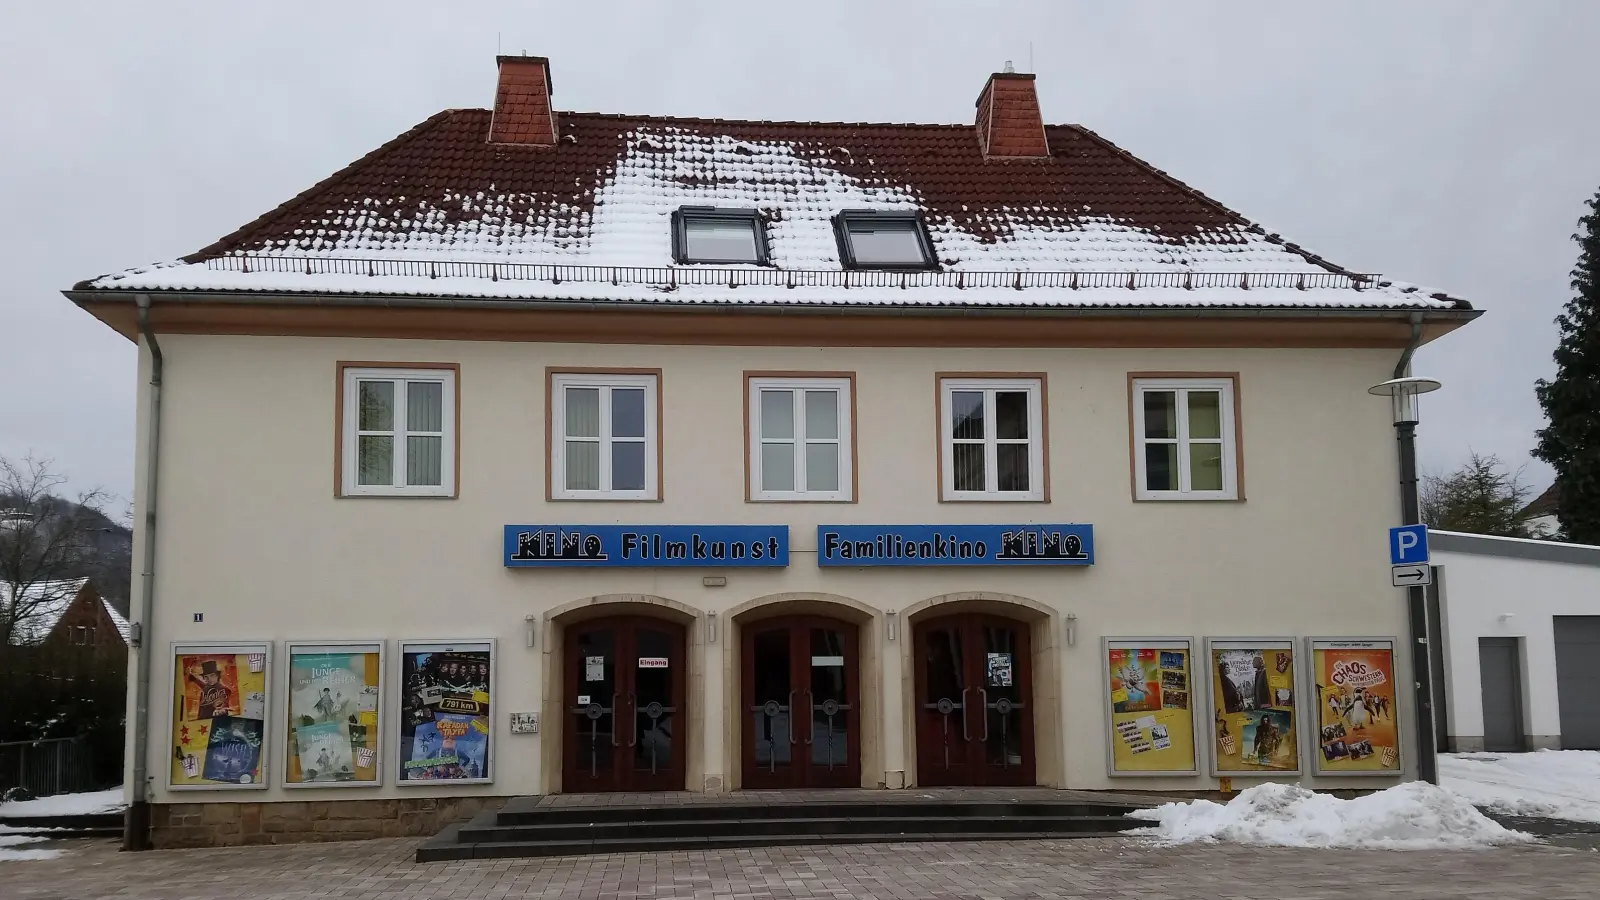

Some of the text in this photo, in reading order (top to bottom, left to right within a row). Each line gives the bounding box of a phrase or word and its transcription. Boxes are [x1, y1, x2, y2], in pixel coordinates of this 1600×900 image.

[511, 528, 778, 560] KINO Filmkunst
[824, 527, 1088, 560] Familienkino KINO
[1398, 531, 1418, 559] P
[640, 659, 667, 667] Eingang
[1333, 662, 1367, 685] CHAOS
[446, 700, 473, 709] 791 km
